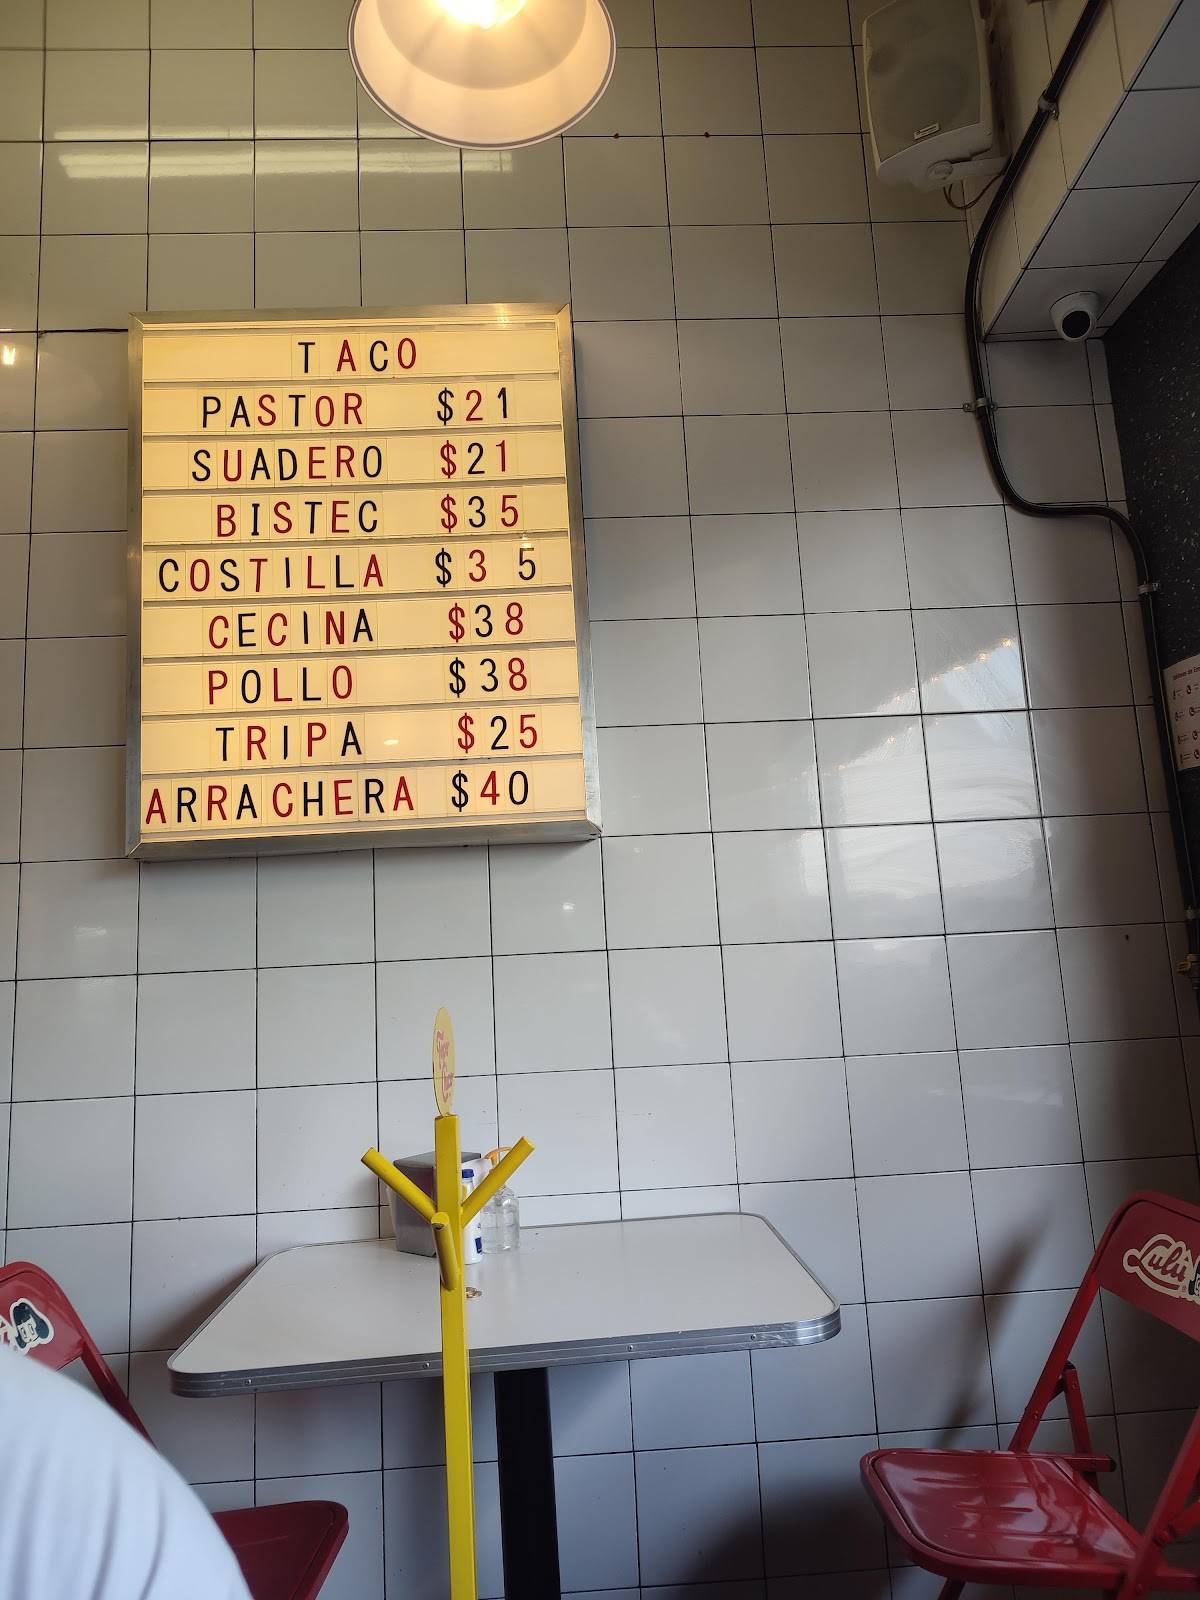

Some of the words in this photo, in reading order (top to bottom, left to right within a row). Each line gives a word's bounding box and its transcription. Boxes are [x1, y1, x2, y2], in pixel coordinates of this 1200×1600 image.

[297, 337, 417, 374] TACO
[202, 392, 363, 429] PASTOR
[436, 386, 508, 427] $21
[191, 445, 382, 482] SUADERO
[440, 439, 506, 480] $21
[216, 500, 378, 538] BISTEC
[440, 493, 519, 534] $35
[158, 553, 384, 593] COSTILLA
[208, 608, 374, 650] CECINA
[448, 601, 524, 644] $38
[208, 664, 353, 705] POLLO
[449, 656, 528, 699] $38
[215, 721, 363, 762] TRIPA
[457, 712, 538, 754] $25
[145, 775, 415, 824] ARRACHERA
[451, 769, 529, 813] $40
